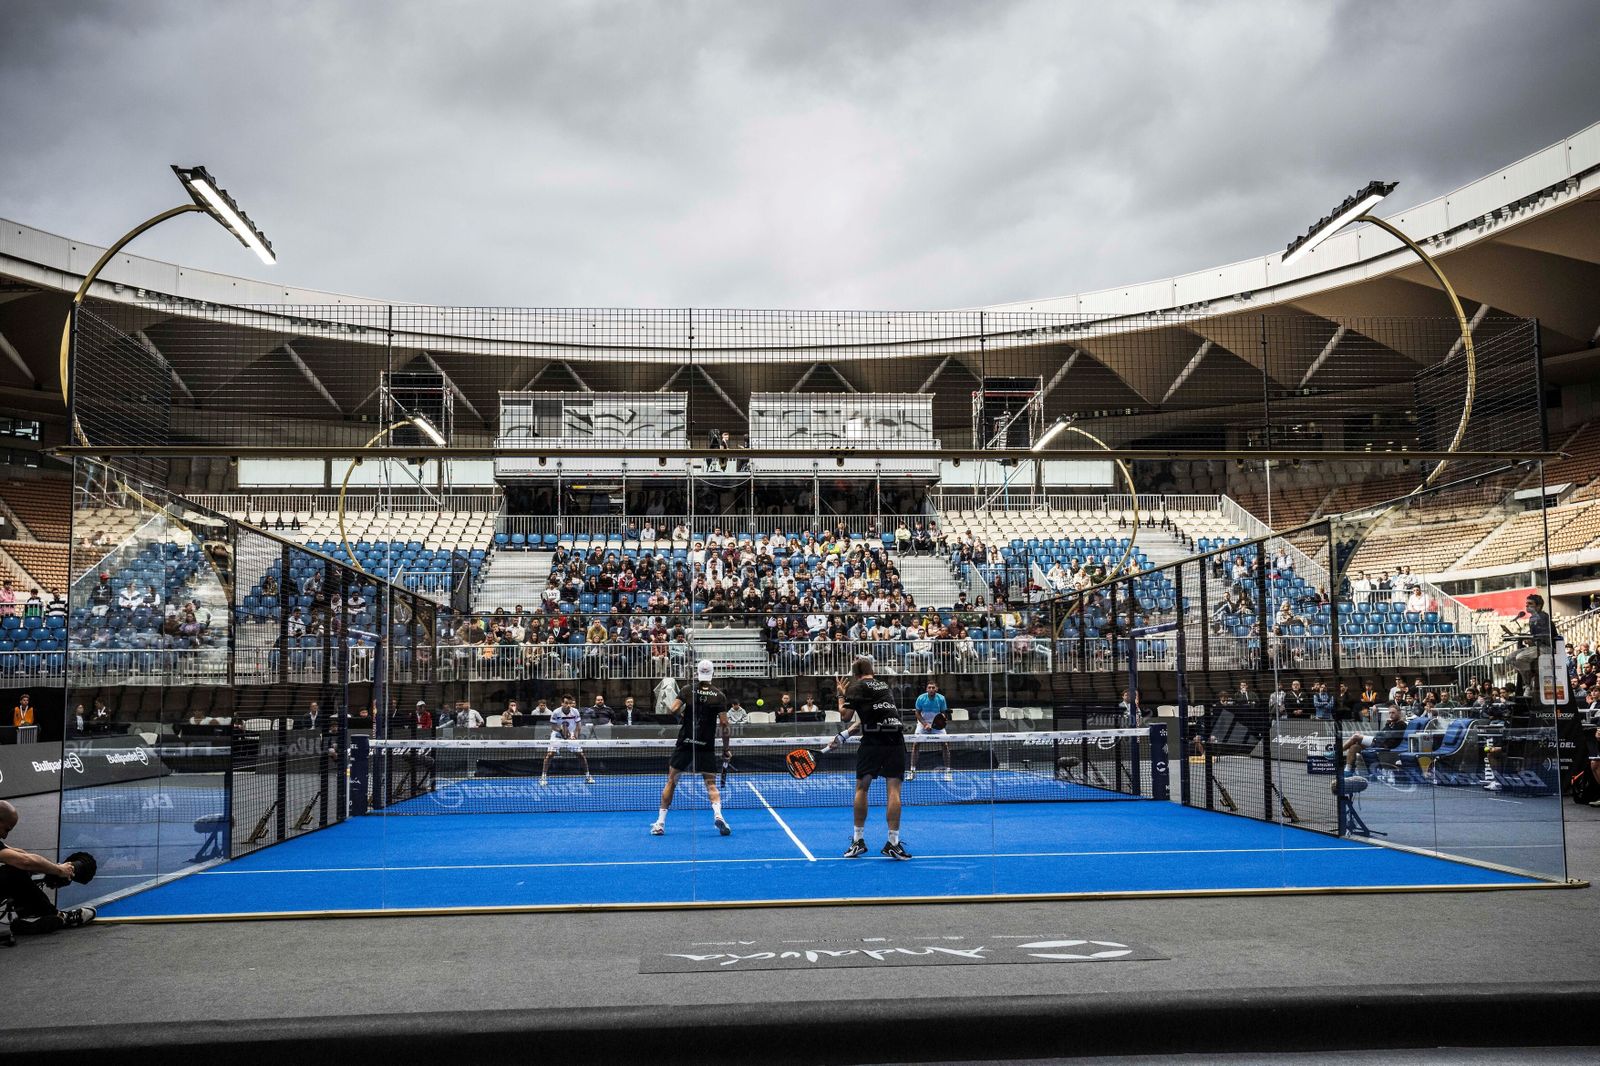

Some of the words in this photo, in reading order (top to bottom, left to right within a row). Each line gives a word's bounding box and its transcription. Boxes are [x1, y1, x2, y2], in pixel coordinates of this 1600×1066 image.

[32, 758, 71, 773] Bullpadel
[105, 751, 139, 766] Bullpadel
[663, 945, 986, 966] Andalucía
